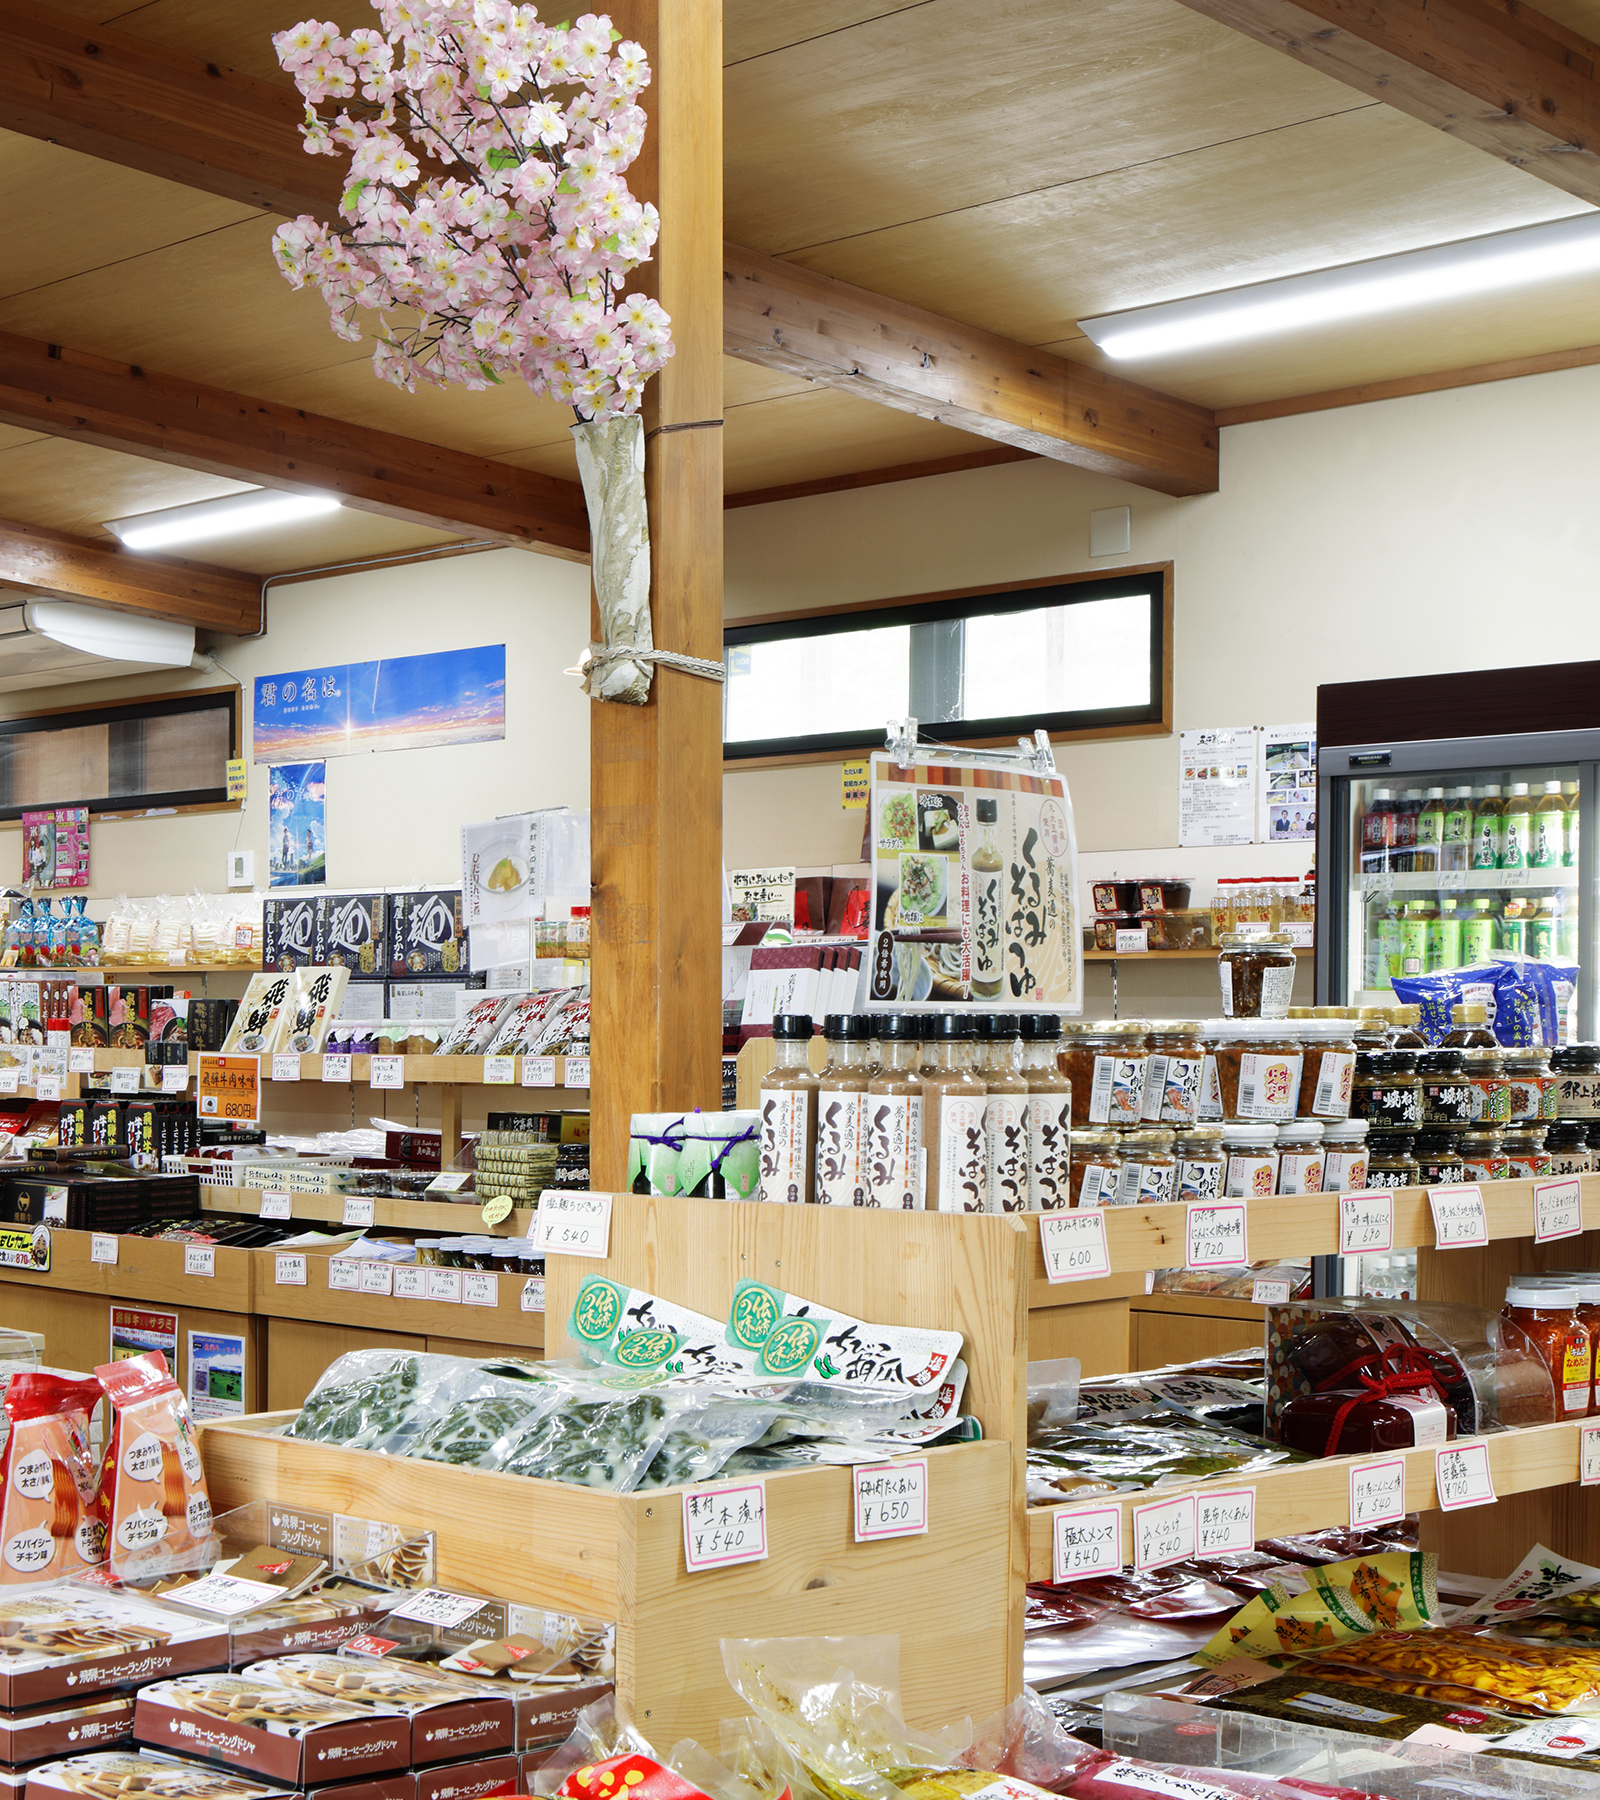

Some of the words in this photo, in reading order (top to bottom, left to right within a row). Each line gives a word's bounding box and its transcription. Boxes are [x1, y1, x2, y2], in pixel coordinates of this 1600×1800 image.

[261, 676, 341, 707] 君の名は。
[879, 838, 904, 850] サラダに
[1481, 825, 1492, 866] 白川茶
[1507, 824, 1518, 865] 白川茶
[1537, 822, 1548, 863] 白川茶
[1022, 827, 1048, 947] くるみ
[960, 874, 971, 999] お料理にも大活躍!
[1005, 862, 1037, 997] そばつゆ
[203, 1071, 255, 1088] 飛騨牛肉味噌
[569, 1074, 585, 1082] ¥870
[1266, 1069, 1278, 1103] にんにく
[225, 1103, 251, 1118] 680円
[761, 1099, 781, 1178] くるみ
[824, 1101, 846, 1182] くるみ
[872, 1105, 895, 1187] くるみ
[959, 1127, 985, 1213] そばつゆ
[997, 1125, 1025, 1213] そばつゆ
[1035, 1124, 1065, 1210] そばつゆ
[1049, 1217, 1100, 1235] くるみそばつゆ
[1191, 1219, 1241, 1240] にんにく肉味噌
[1195, 1209, 1216, 1222] ひだ牛
[125, 1516, 163, 1531] スパイシー
[282, 1514, 328, 1533] 飛騨コーヒー
[704, 1498, 764, 1526] 一本漬け
[1144, 1512, 1181, 1540] 山くらげ
[1203, 1506, 1250, 1526] 昆布たくあん
[13, 1538, 52, 1550] スパイシー
[128, 1529, 158, 1542] チキン味
[281, 1532, 322, 1549] ラングドシャ
[1065, 1525, 1113, 1548] 極太メンマ
[16, 1550, 48, 1562] チキン味
[79, 1656, 173, 1684] 飛騨コーヒーラングドシャ
[180, 1720, 256, 1753] 飛騨コーヒーラングドシャ
